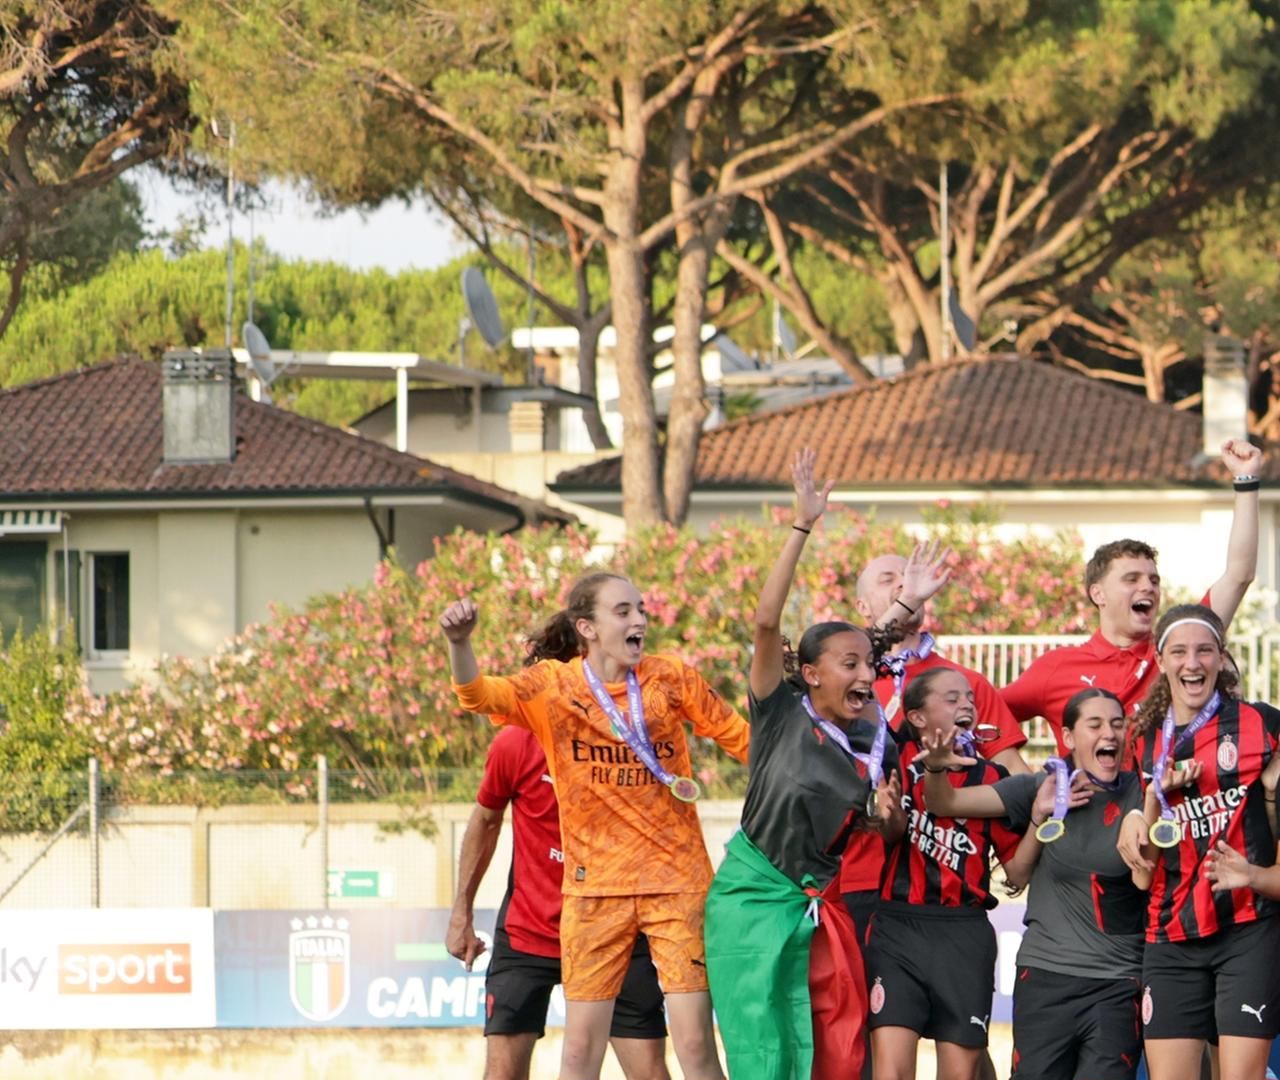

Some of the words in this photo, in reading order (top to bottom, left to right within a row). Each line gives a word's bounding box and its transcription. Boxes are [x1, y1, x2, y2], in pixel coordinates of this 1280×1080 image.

[571, 739, 675, 764] Emires
[591, 766, 612, 785] FLY
[616, 768, 656, 787] BETT
[1170, 784, 1248, 825] mirates
[1190, 810, 1236, 840] BETTE
[298, 938, 345, 960] ITALIA
[0, 946, 48, 993] ky
[63, 951, 184, 992] sport
